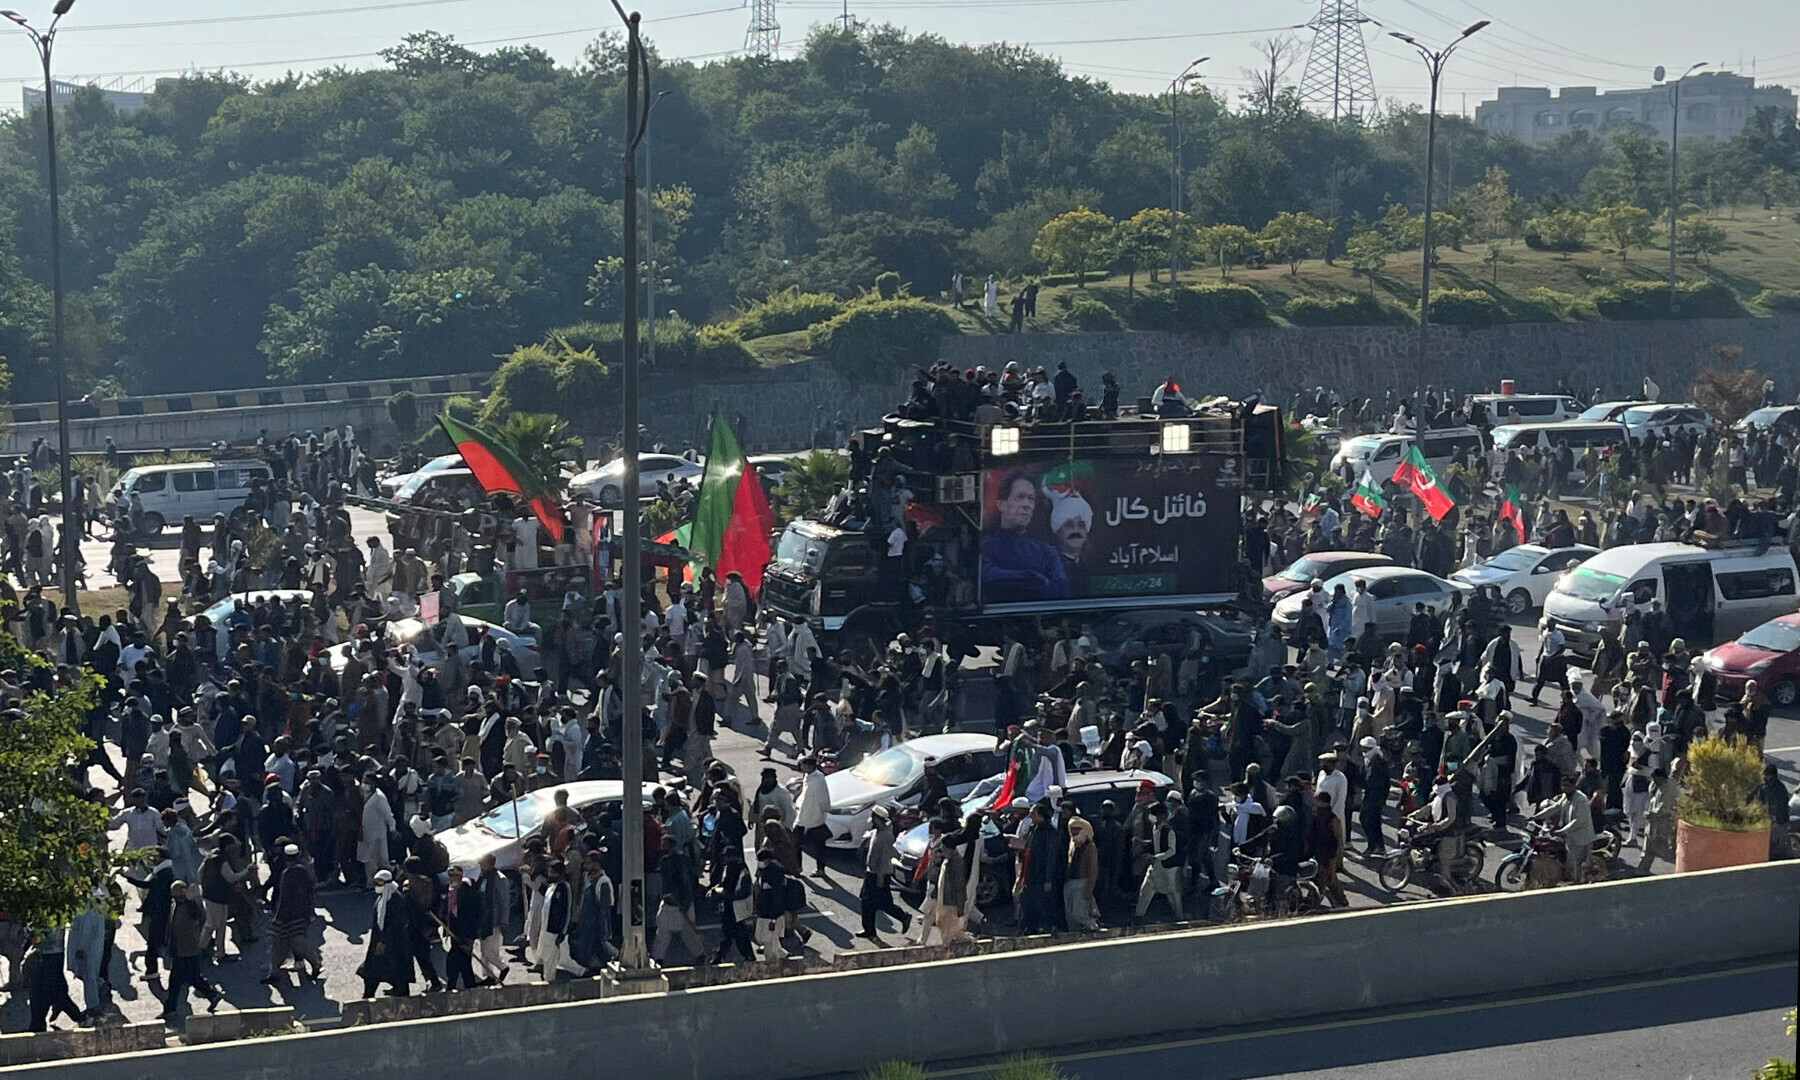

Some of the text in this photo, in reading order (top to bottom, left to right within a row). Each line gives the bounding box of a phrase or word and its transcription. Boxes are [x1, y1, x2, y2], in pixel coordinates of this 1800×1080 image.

[1106, 492, 1207, 526] فائنل کال
[1109, 543, 1179, 568] اسلام آباد
